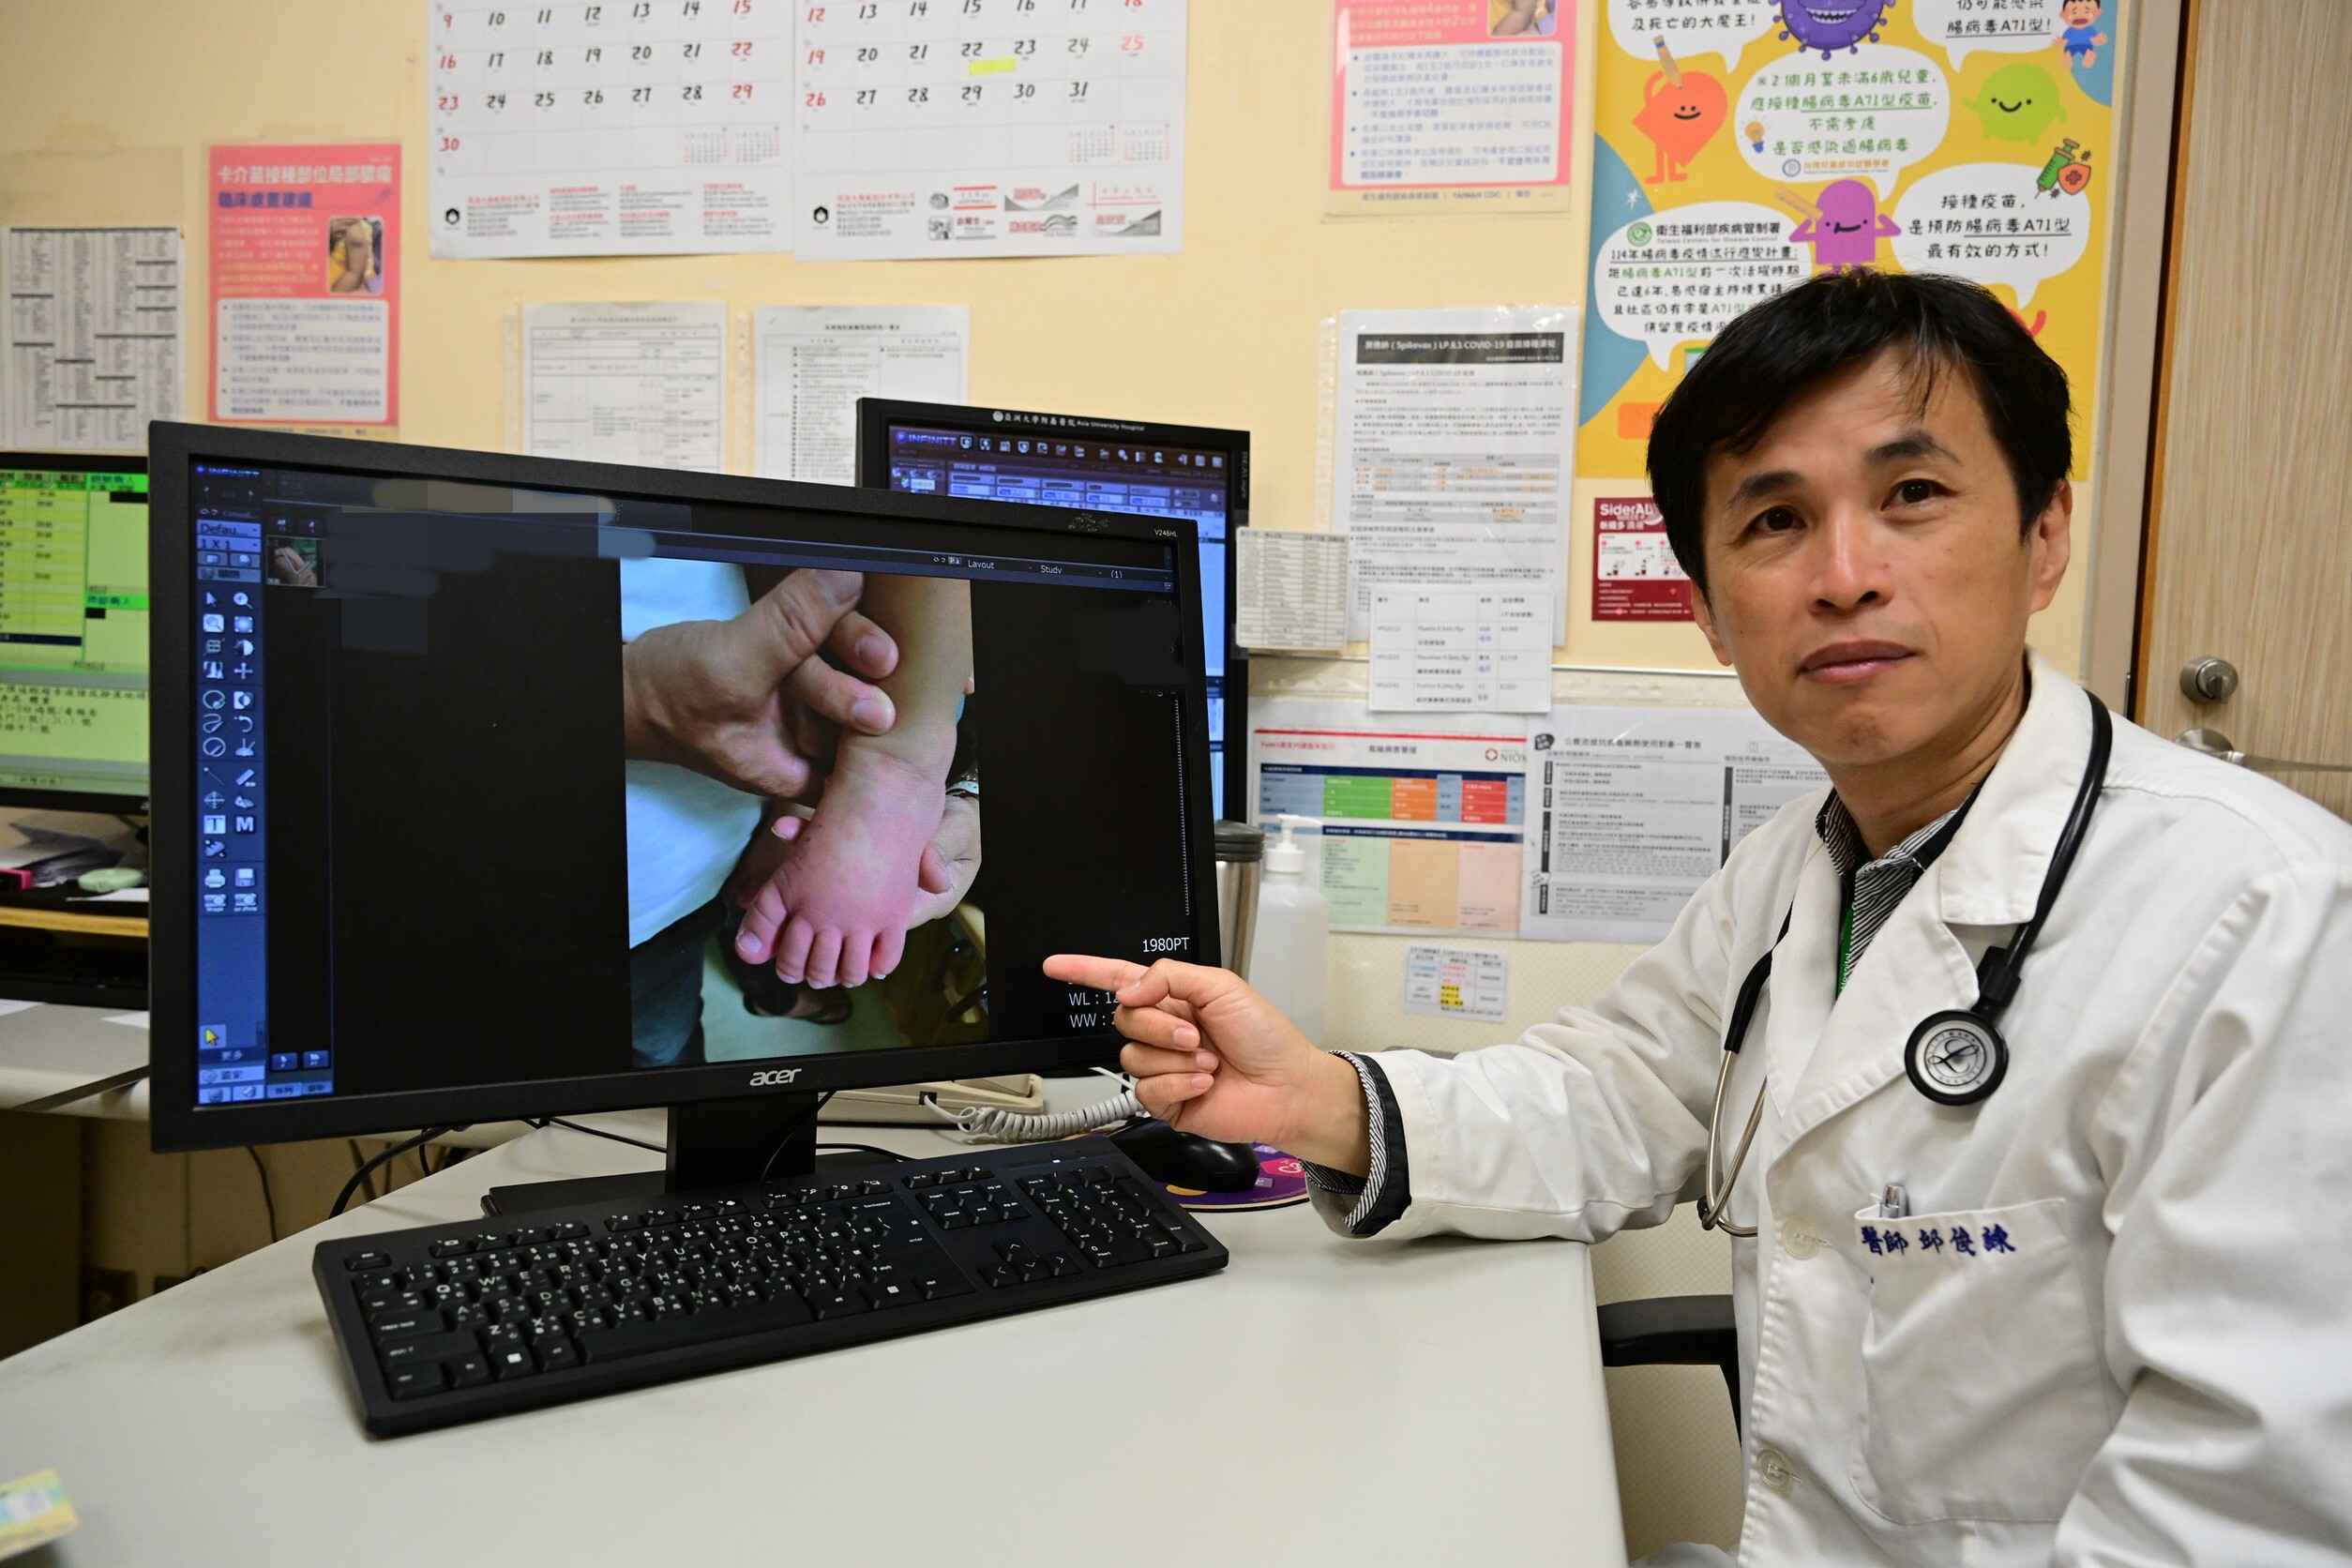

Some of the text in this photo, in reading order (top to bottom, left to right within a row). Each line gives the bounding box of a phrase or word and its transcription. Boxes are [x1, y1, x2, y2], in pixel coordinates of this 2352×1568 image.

[445, 0, 750, 27] 9 10 11 12 13 14 15
[808, 8, 825, 22] 12
[860, 5, 876, 19] 13
[911, 2, 927, 16] 14
[964, 0, 981, 13] 15
[441, 42, 752, 68] 16 17 18 19 20 21 22
[808, 36, 1143, 65] 19 20 21 22 23 24 25
[440, 85, 752, 110] 23 24 25 26 27 28 29
[807, 83, 1088, 106] 26 27 28 29 30 31
[440, 138, 460, 151] 30
[1656, 222, 1780, 235] 衛生福利部疾病管制署
[908, 434, 957, 446] INFINITT
[1154, 529, 1178, 537] V246HL
[1142, 937, 1190, 953] 1980PT
[1068, 993, 1091, 1006] WL
[1069, 1014, 1097, 1028] WW
[749, 1068, 802, 1087] acer
[1861, 1225, 1908, 1257] 醫師
